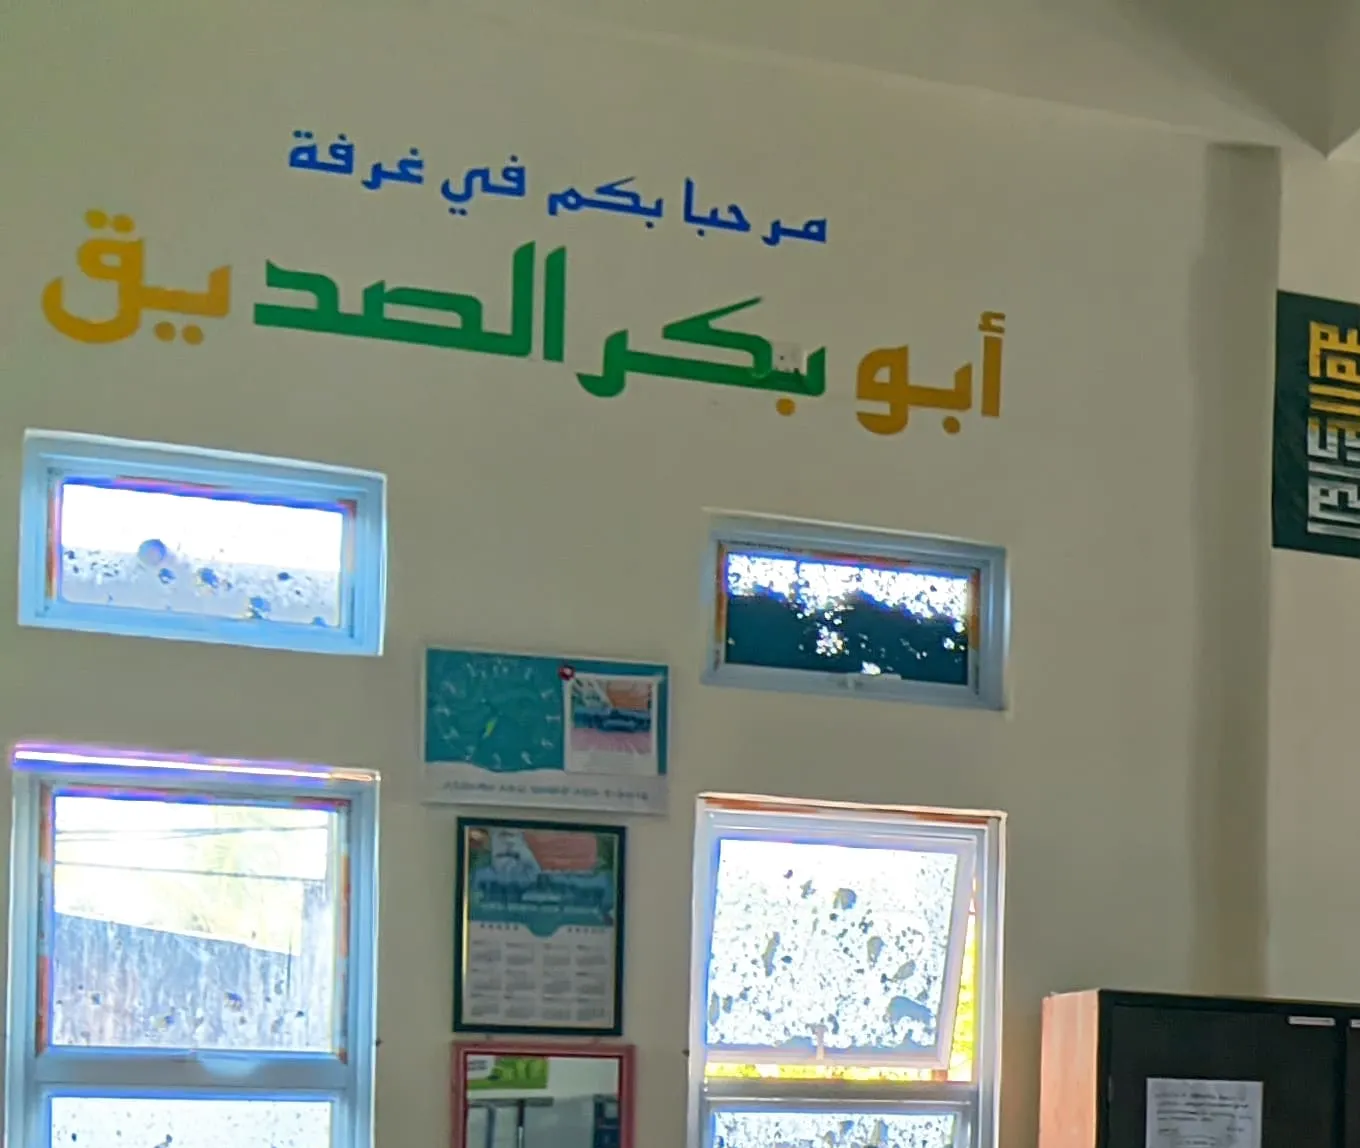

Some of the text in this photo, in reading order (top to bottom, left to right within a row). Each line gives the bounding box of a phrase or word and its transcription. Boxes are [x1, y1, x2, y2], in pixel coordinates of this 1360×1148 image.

[288, 129, 827, 247] مرحبا بكم في غرفة
[575, 296, 827, 417] بكر
[856, 311, 1006, 436] أبو
